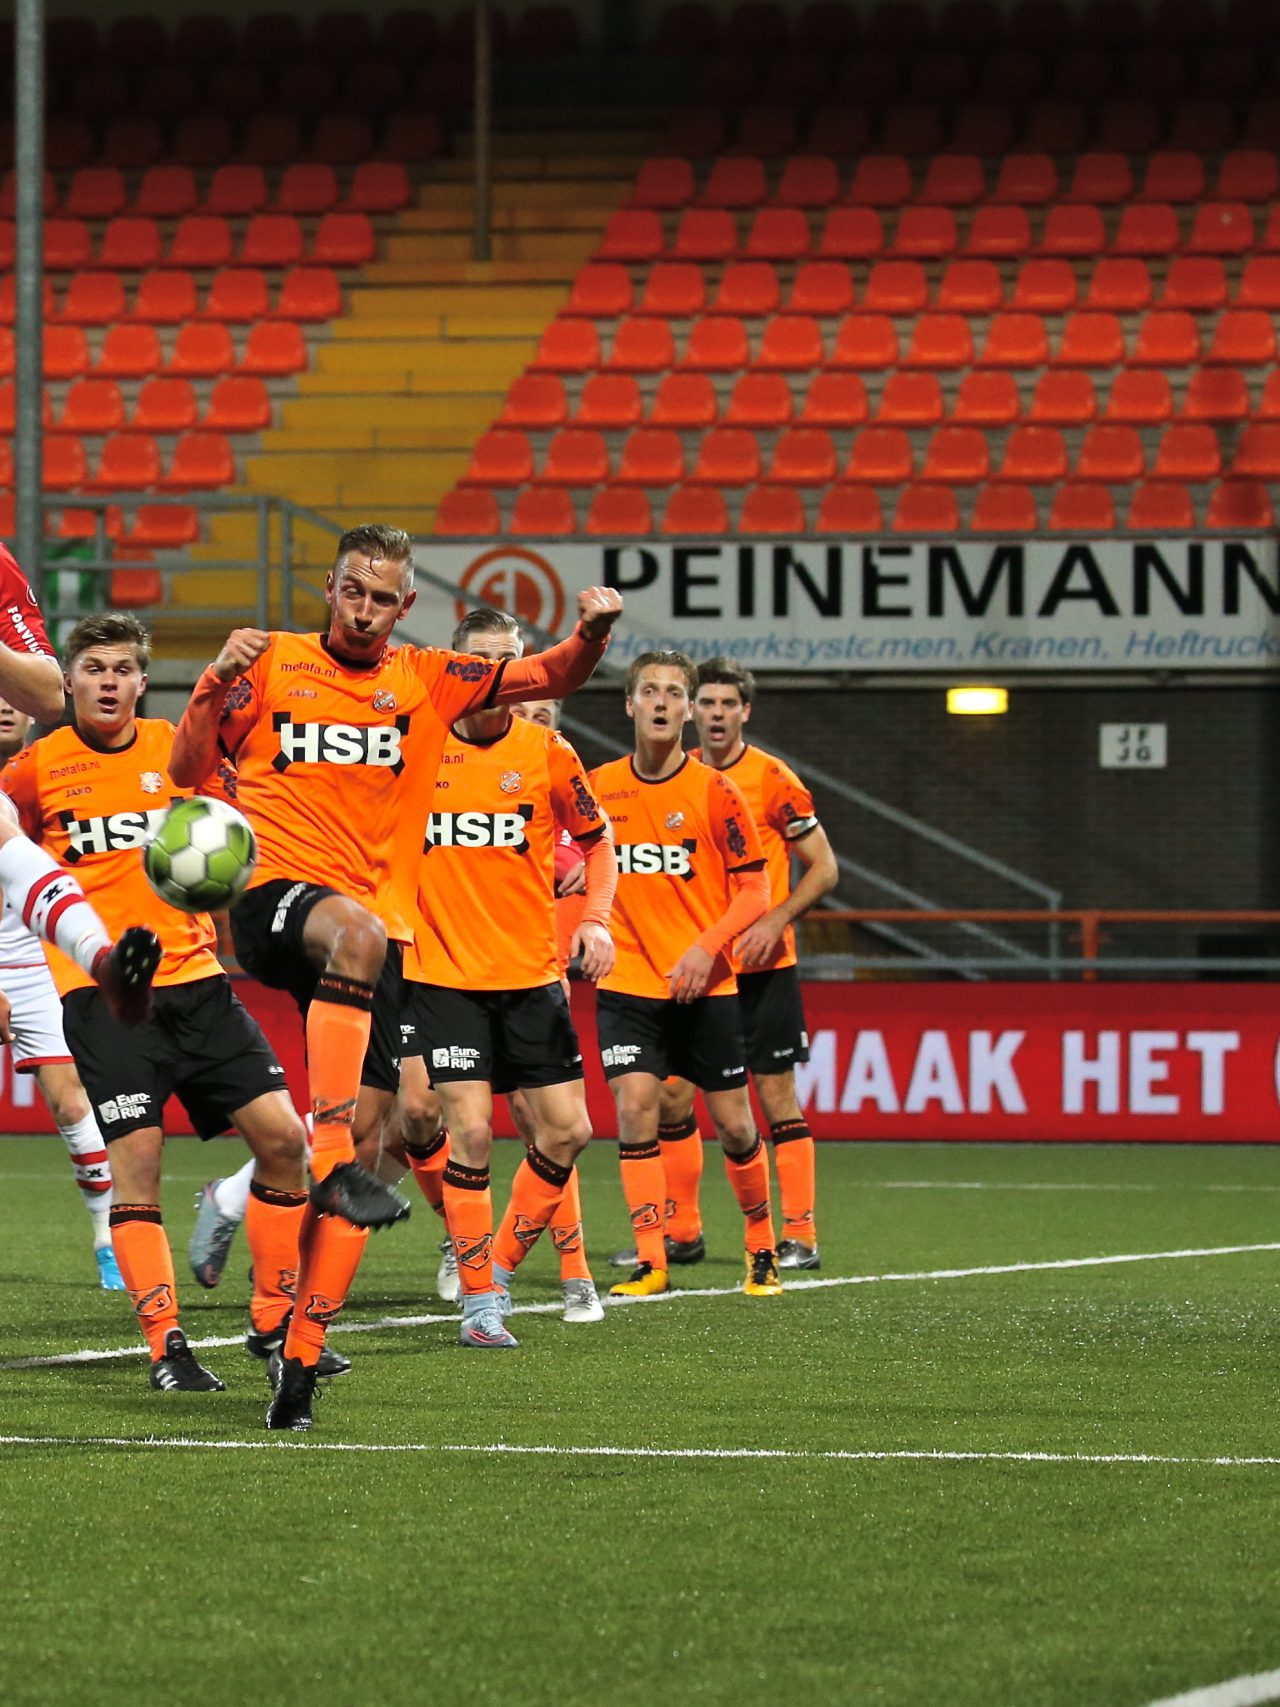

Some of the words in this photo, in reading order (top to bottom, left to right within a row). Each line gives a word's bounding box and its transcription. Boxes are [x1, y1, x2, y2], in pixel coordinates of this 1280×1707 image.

[603, 544, 1280, 617] PEINEMANN
[280, 662, 337, 679] metafa.nl
[280, 722, 402, 767] HSB
[49, 761, 100, 780] metafa.nl
[65, 786, 92, 798] JAKO
[428, 812, 526, 848] HSB
[451, 1058, 475, 1070] Rijn
[795, 1030, 1028, 1114] MAAK
[1062, 1031, 1239, 1115] HET
[120, 1104, 146, 1119] Rijn
